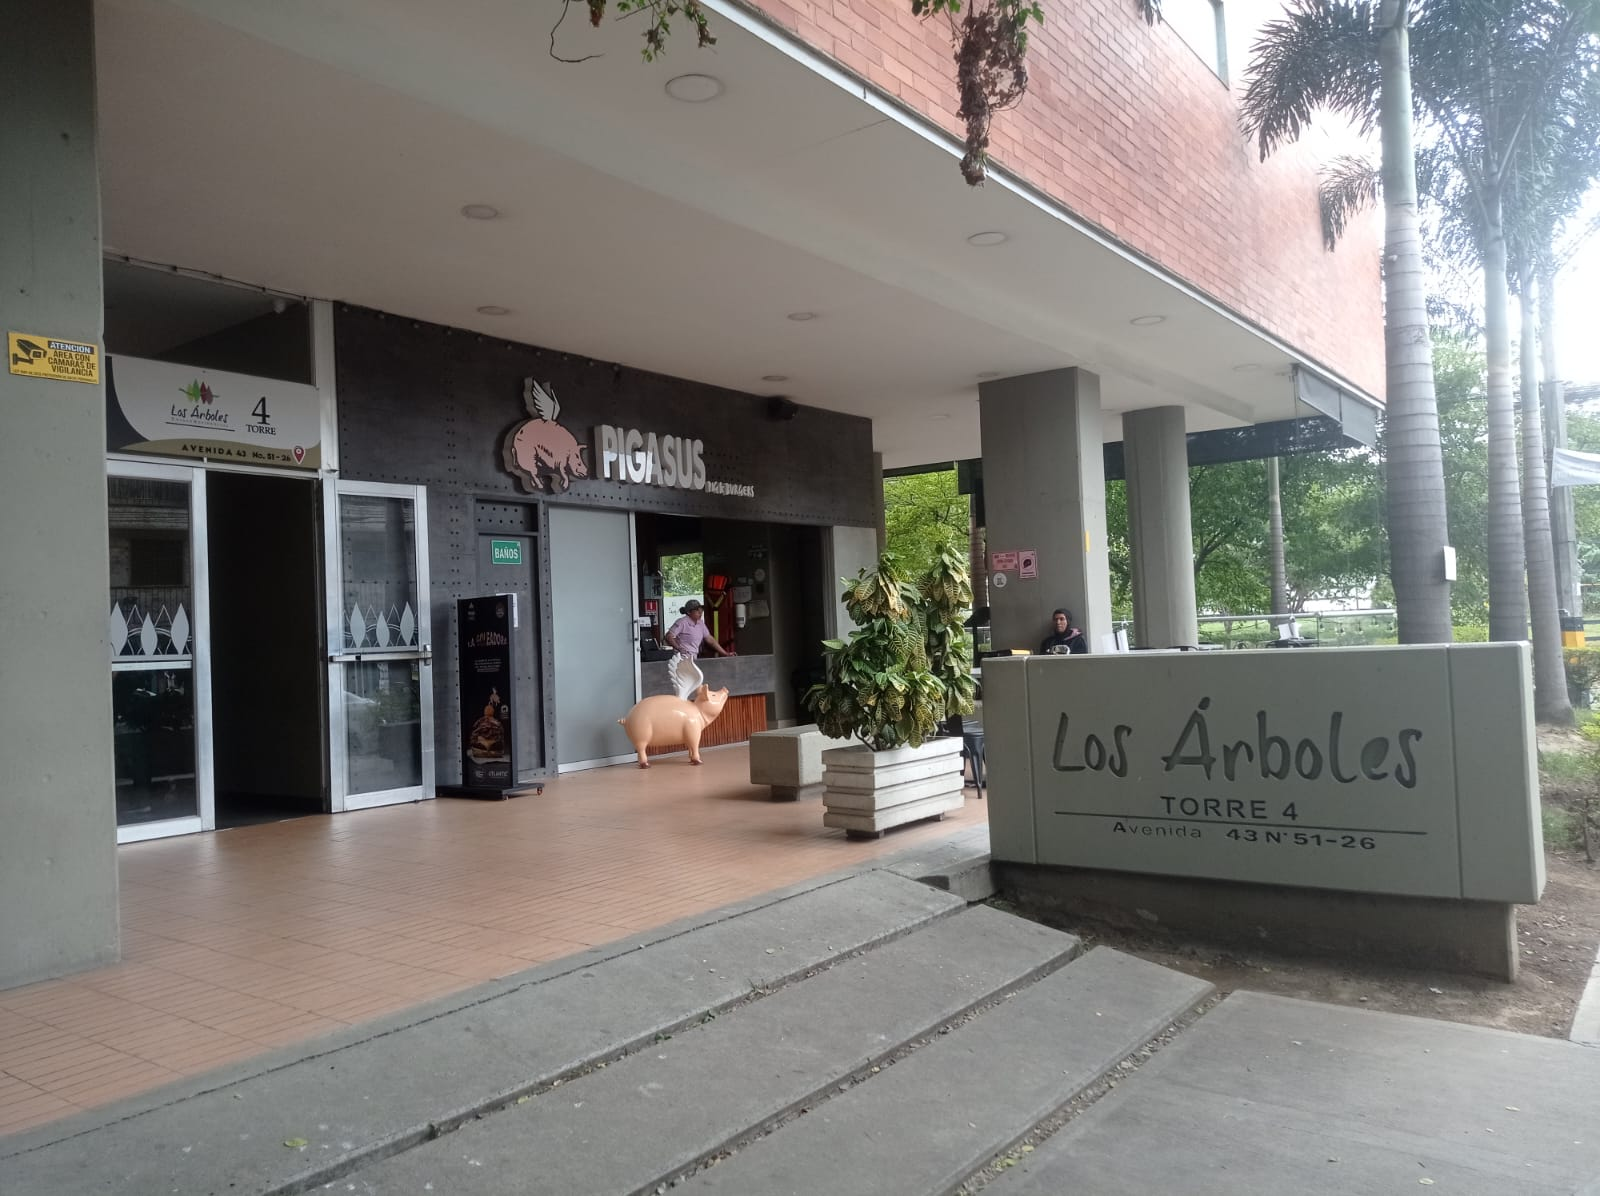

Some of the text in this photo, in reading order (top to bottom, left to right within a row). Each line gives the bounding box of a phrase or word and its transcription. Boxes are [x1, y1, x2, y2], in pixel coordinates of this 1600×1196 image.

[50, 342, 91, 354] ATENCION
[48, 357, 96, 371] CAMARAS DE
[53, 351, 91, 363] AREA CON
[51, 365, 94, 378] VIGILANCIA
[171, 404, 187, 419] Los
[190, 405, 229, 424] Árboles
[251, 396, 271, 426] 4
[245, 424, 277, 436] TORRE
[181, 444, 233, 457] AVENIDA
[236, 450, 247, 458] 43
[594, 424, 706, 491] PIGASUS
[494, 546, 519, 560] BAÑOS
[1052, 696, 1423, 790] Los Árboles
[1160, 796, 1299, 821] TORRE 4
[1112, 821, 1202, 839] Avenida
[1226, 828, 1258, 842] 43
[1294, 832, 1377, 850] 51-26
